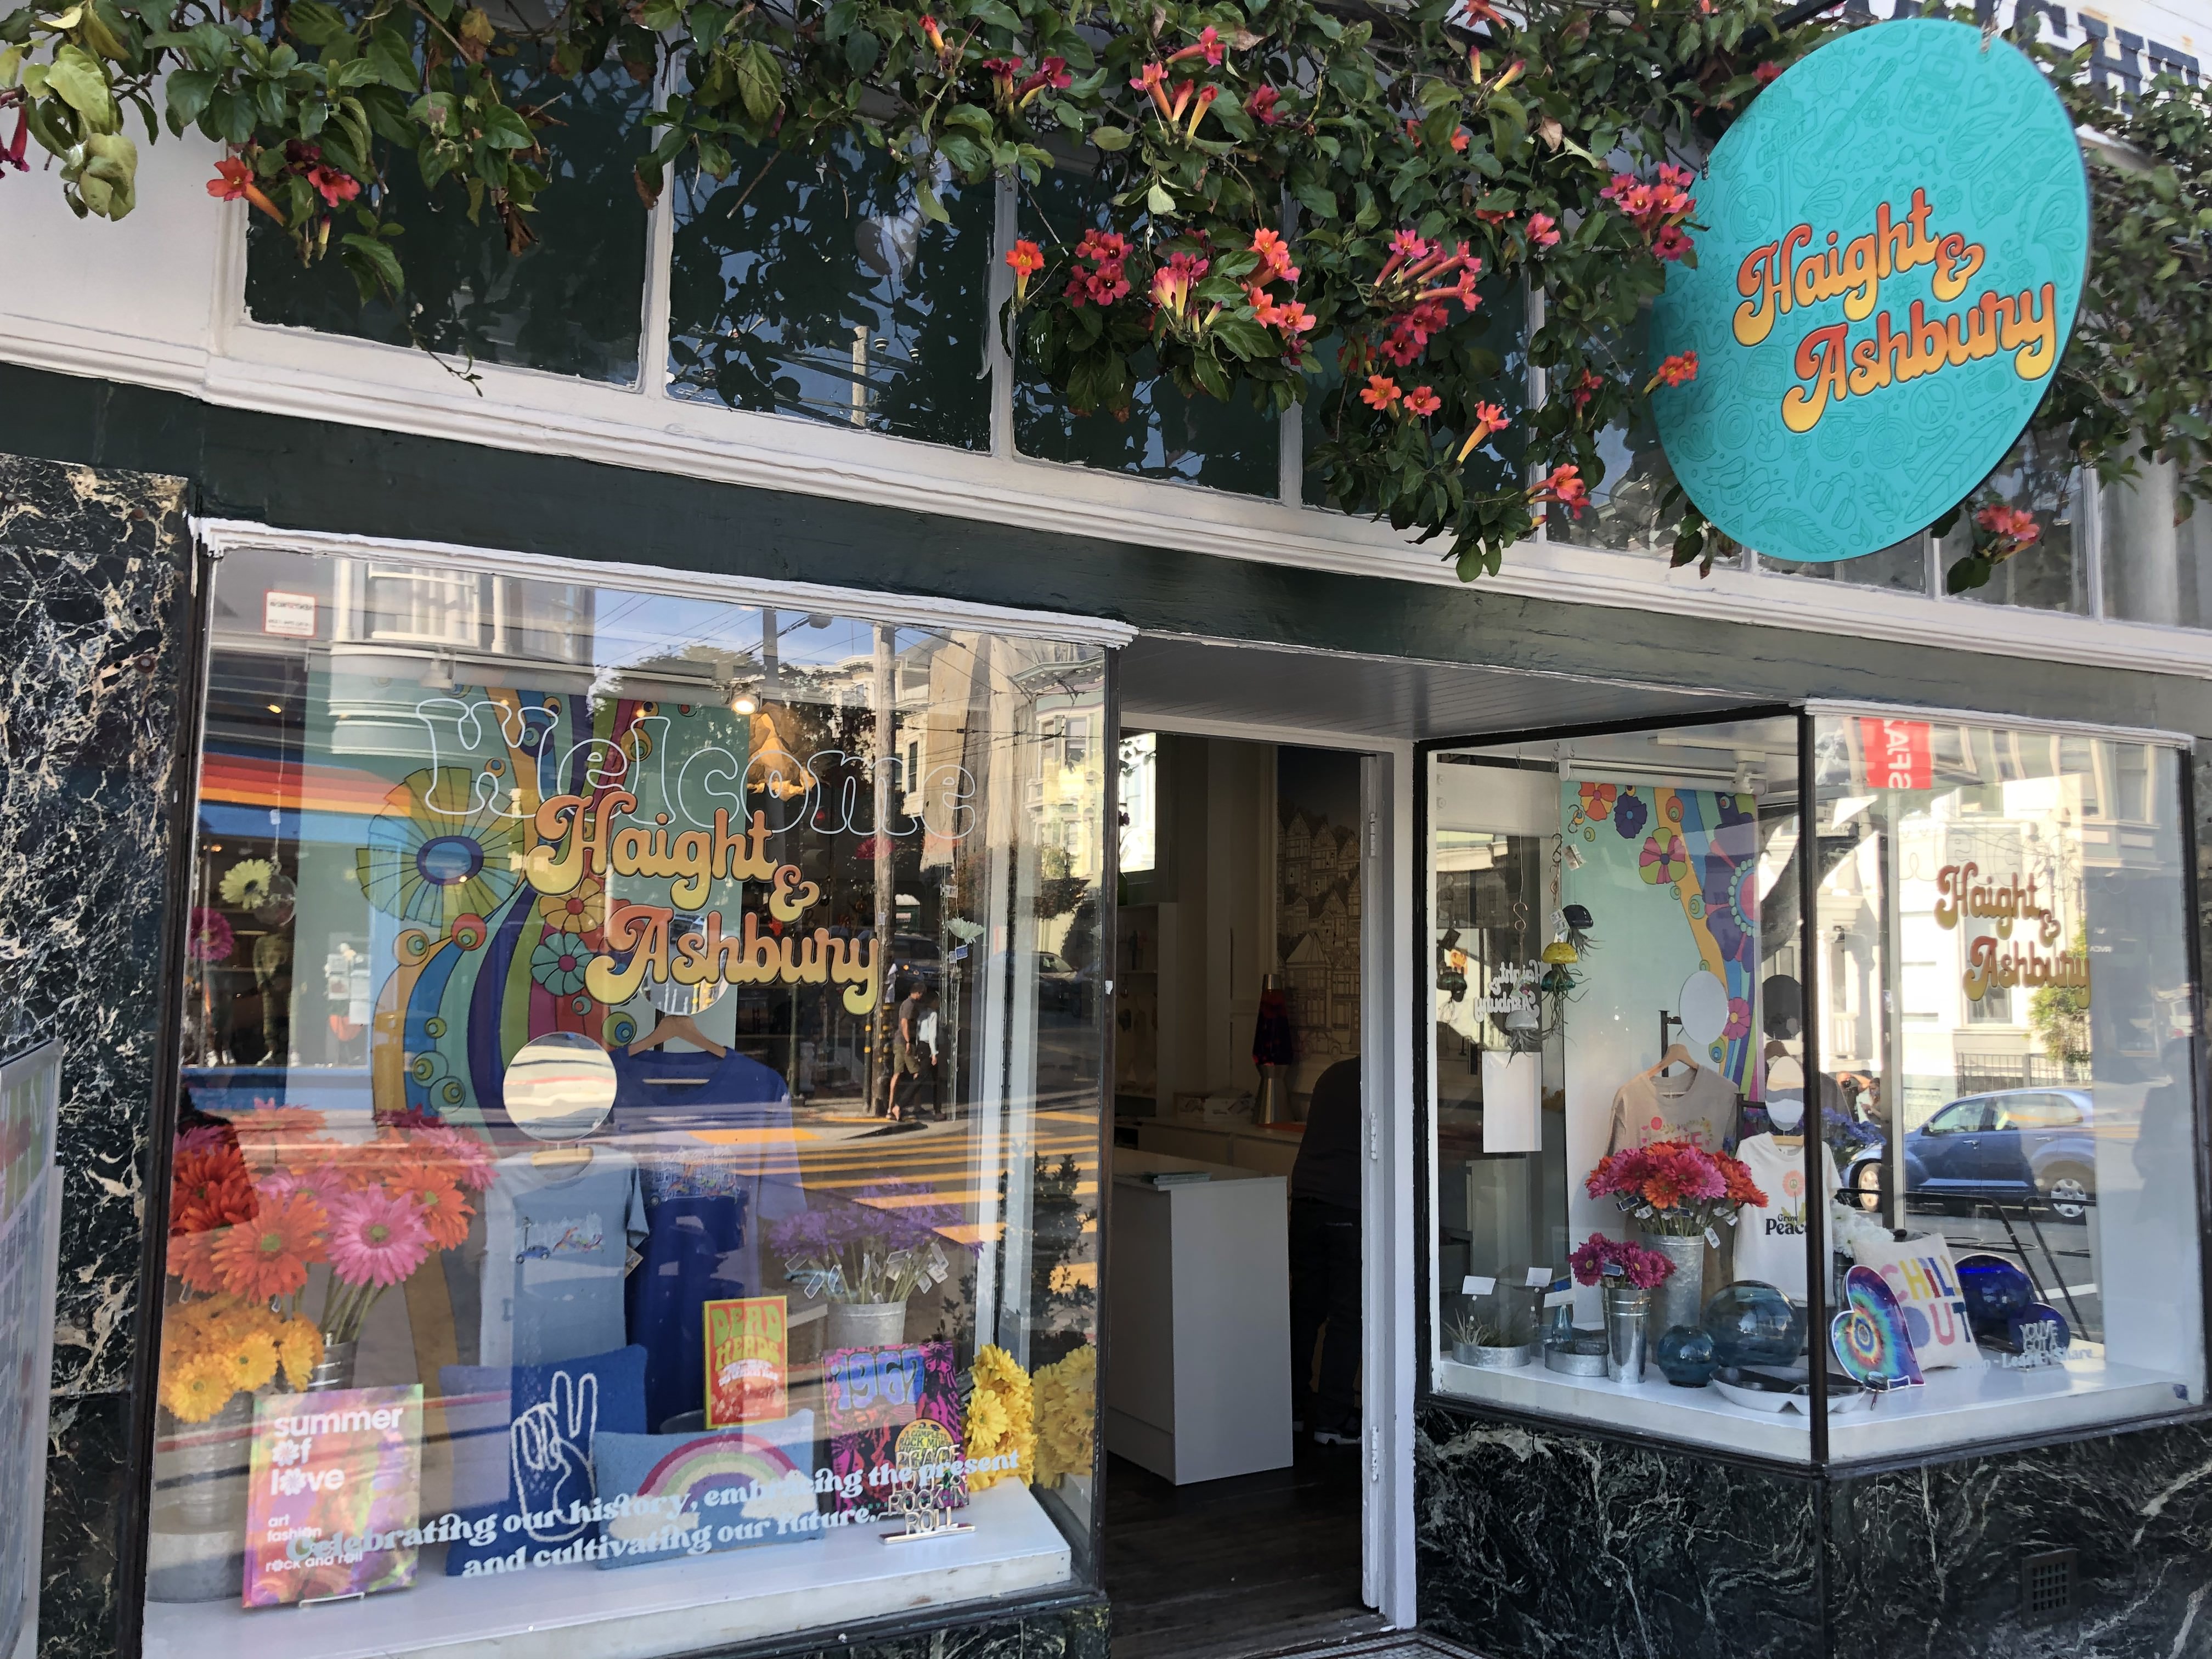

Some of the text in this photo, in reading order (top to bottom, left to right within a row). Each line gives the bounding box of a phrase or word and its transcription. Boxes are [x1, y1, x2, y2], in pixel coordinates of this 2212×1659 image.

[1763, 119, 1806, 160] HAIGHT
[1733, 187, 1985, 347] Haight &
[1781, 281, 2057, 434] Ashbury
[416, 697, 976, 840] Welcome
[526, 791, 821, 923] Haight &
[1933, 861, 2062, 948] Haight &
[584, 905, 880, 1016] Ashbury
[1962, 935, 2091, 1009] Ashbury
[1765, 1218, 1807, 1235] Peac
[1778, 1213, 1798, 1222] Grow
[1880, 1255, 1962, 1303] CHILL
[711, 1304, 782, 1348] DEAD
[1901, 1301, 1971, 1348] OUT
[715, 1334, 781, 1372] HEADS
[831, 1349, 926, 1410] 1967
[274, 1407, 404, 1437] summer
[272, 1437, 313, 1466] of
[270, 1468, 345, 1497] love
[888, 1484, 944, 1516] ROCK
[268, 1514, 290, 1528] art
[286, 1448, 1019, 1562] Celebrating our history, embracing the present
[905, 1505, 958, 1535] ROLL
[267, 1526, 323, 1543] fashion
[462, 1508, 878, 1578] and cultivating our future.
[266, 1550, 363, 1572] rock and roll
